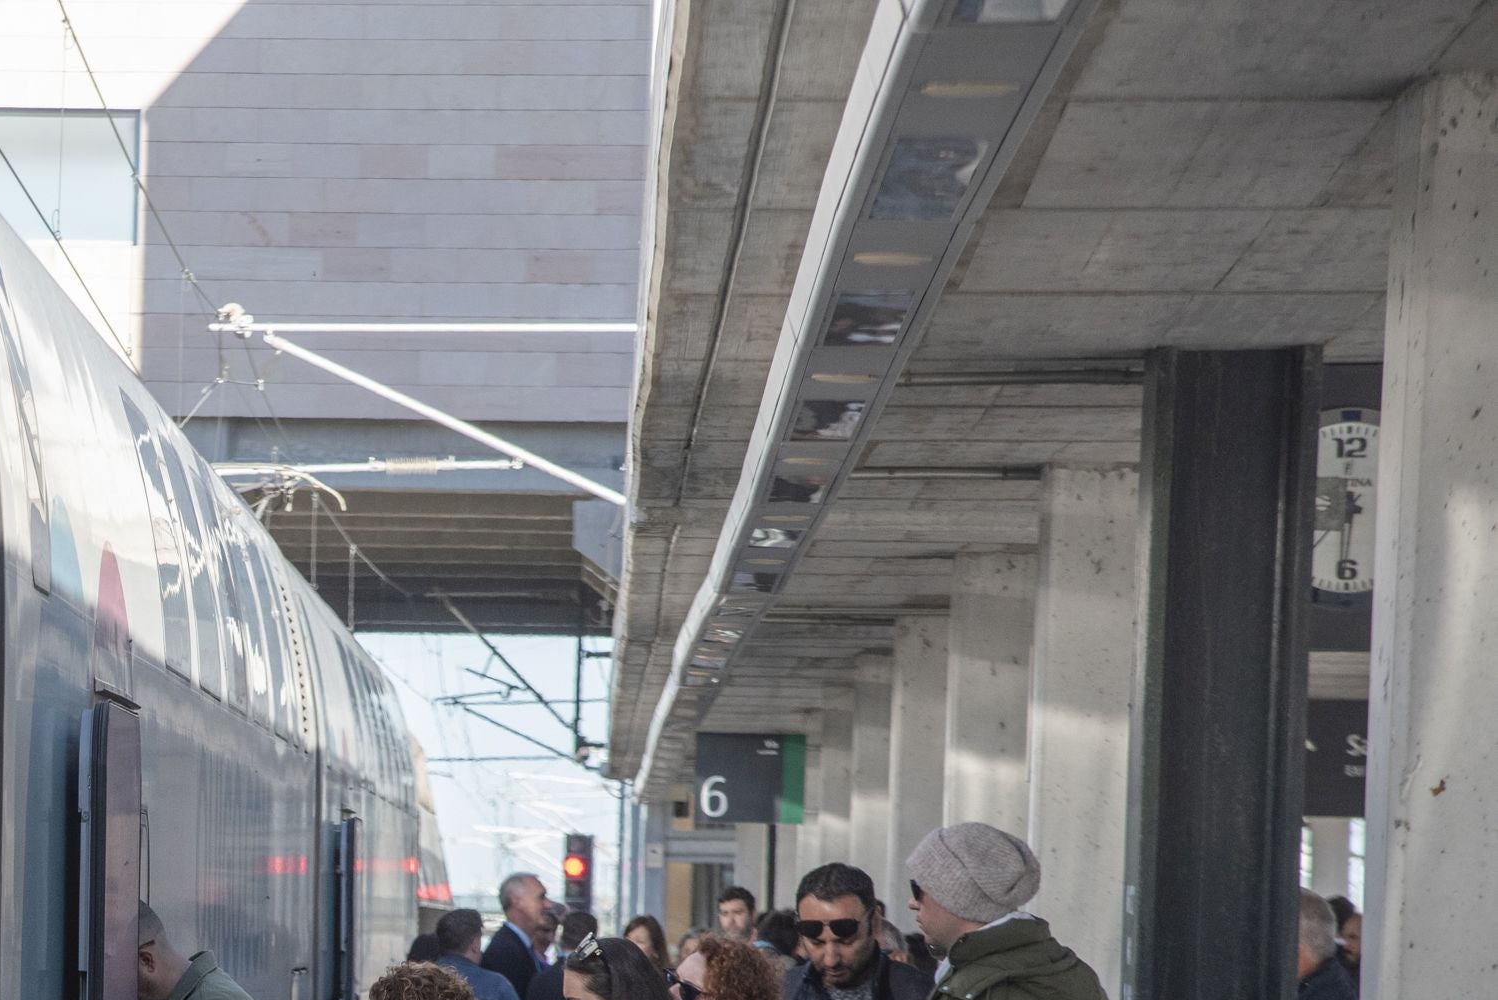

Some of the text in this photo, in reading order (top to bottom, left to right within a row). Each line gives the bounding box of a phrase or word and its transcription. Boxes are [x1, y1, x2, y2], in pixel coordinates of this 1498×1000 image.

[1332, 437, 1367, 458] 12
[1336, 559, 1358, 580] 6
[700, 775, 728, 817] 6
